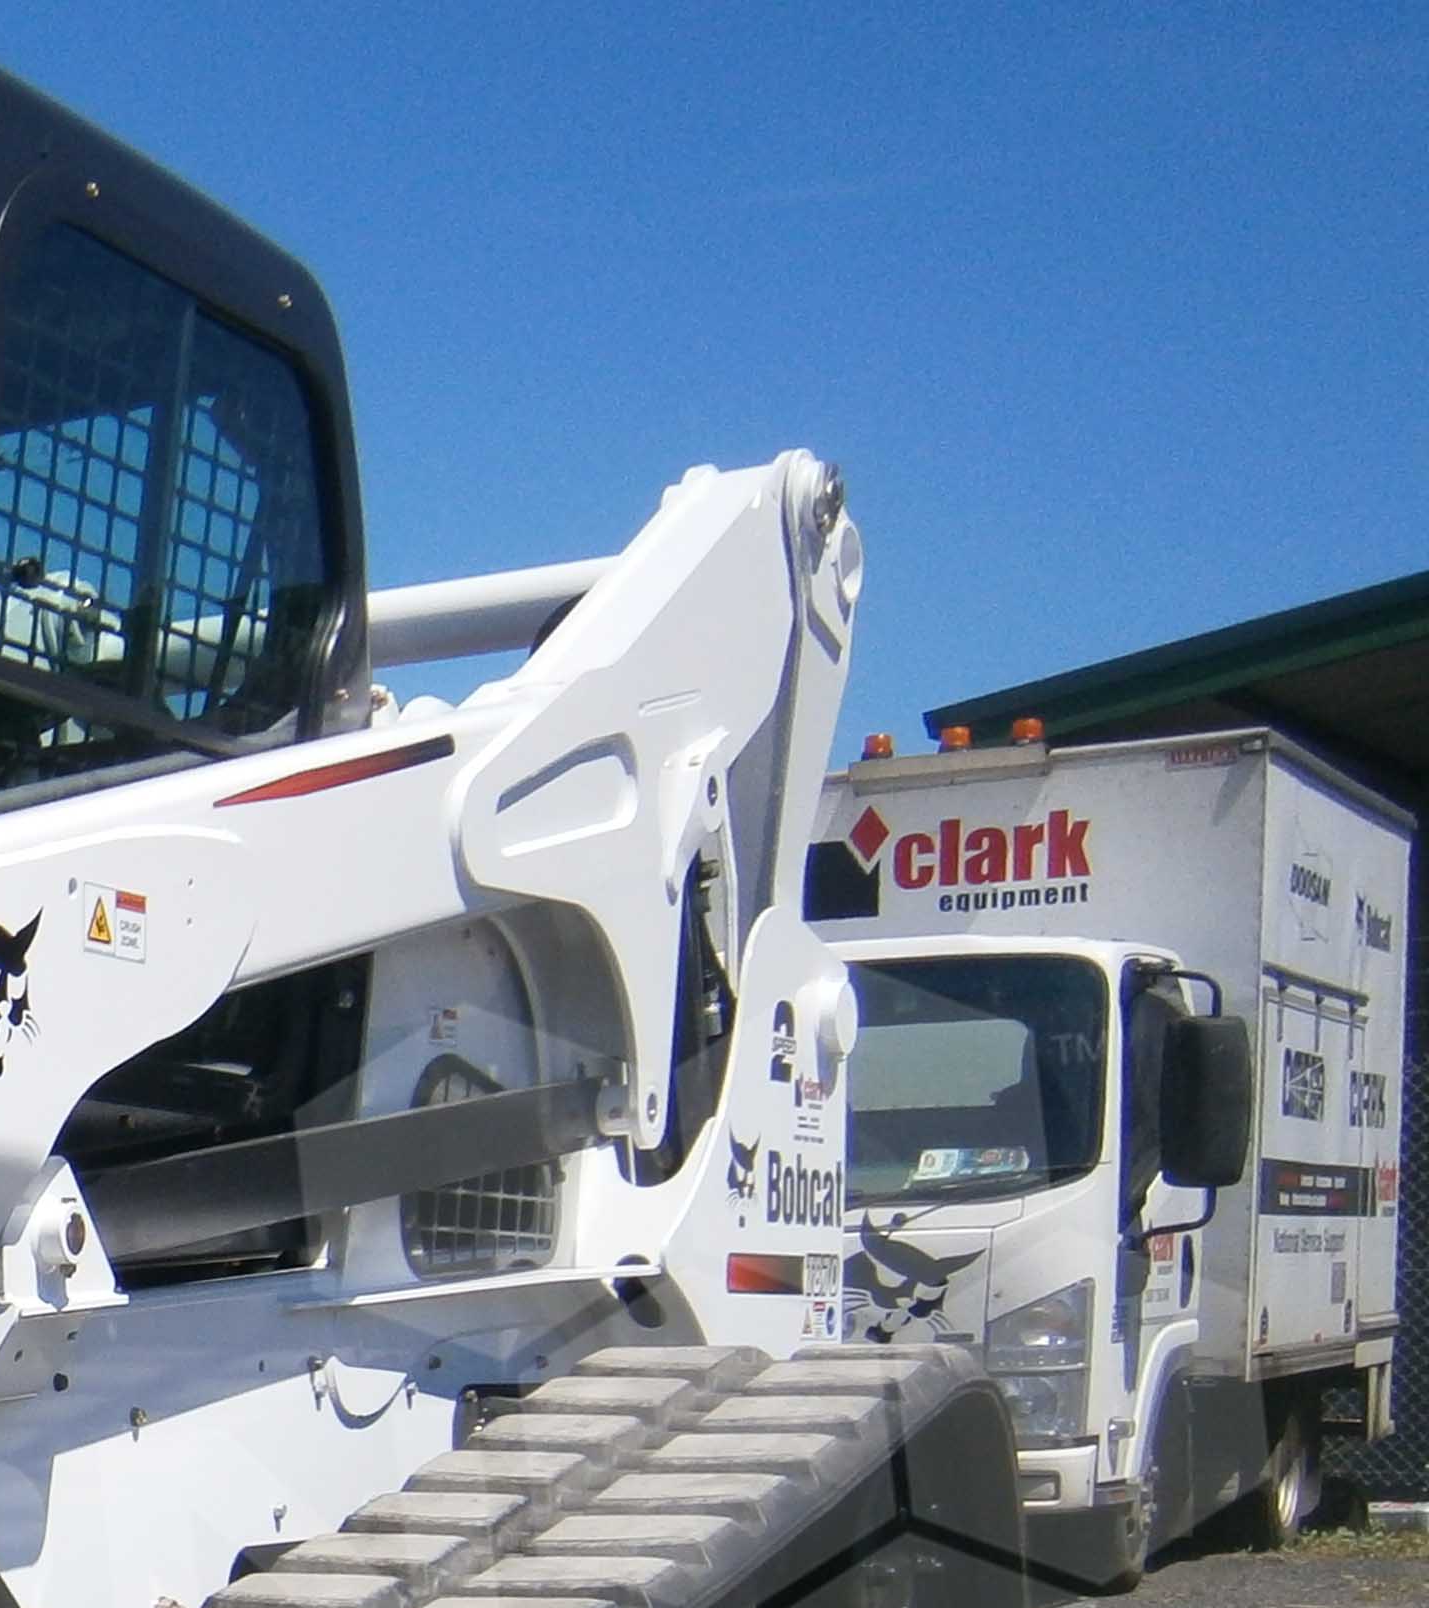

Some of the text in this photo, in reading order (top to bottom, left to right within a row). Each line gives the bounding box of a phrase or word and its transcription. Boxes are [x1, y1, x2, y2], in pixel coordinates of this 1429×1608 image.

[893, 808, 1092, 890] clark
[938, 881, 1089, 913] equipment
[766, 1149, 842, 1228] Bobcat
